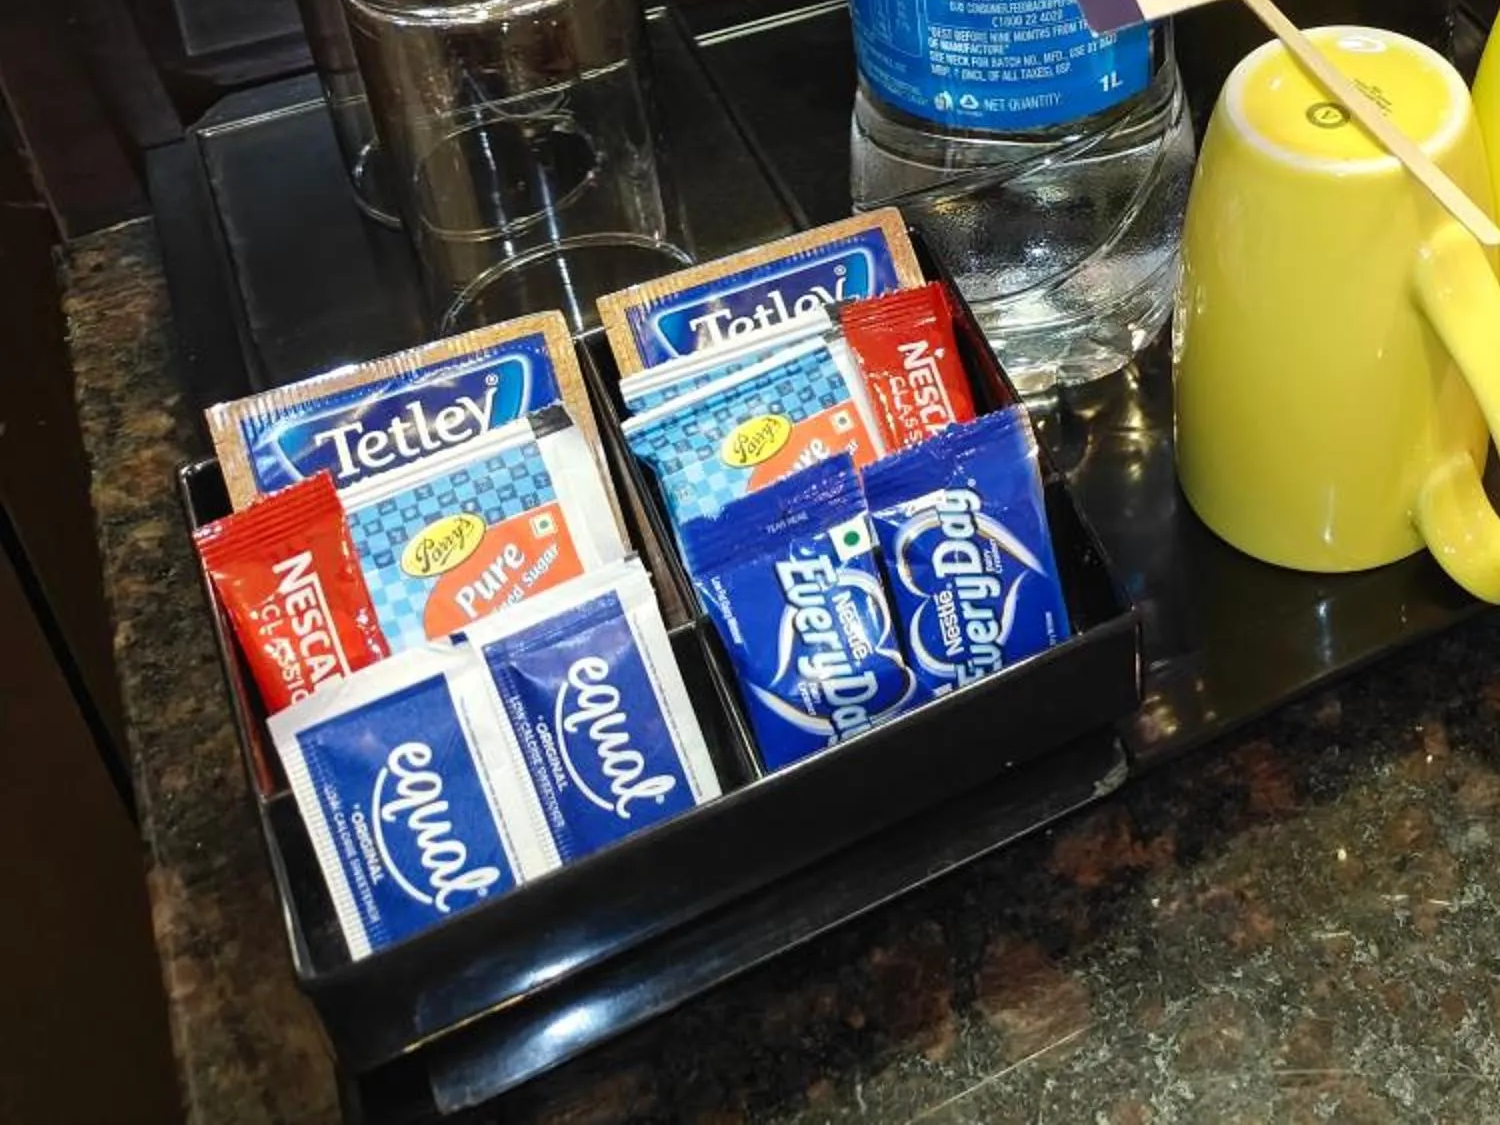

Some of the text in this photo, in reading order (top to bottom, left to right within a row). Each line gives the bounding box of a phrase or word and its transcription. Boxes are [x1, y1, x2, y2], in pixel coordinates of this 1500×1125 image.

[971, 55, 990, 68] FOR
[1013, 24, 1051, 42] MONTHS
[1052, 20, 1078, 37] FROM
[983, 98, 1007, 112] NET
[1100, 70, 1124, 93] 1L
[689, 276, 848, 346] Tetley
[314, 383, 499, 477] Tetley
[734, 417, 779, 458] Parry's
[415, 516, 475, 574] Parry's
[521, 543, 560, 588] sugar
[454, 543, 526, 619] Pure
[535, 722, 569, 794] ORIGINAL
[567, 656, 675, 819] equal
[351, 811, 385, 886] ORIGINAL
[381, 741, 500, 912] equal
